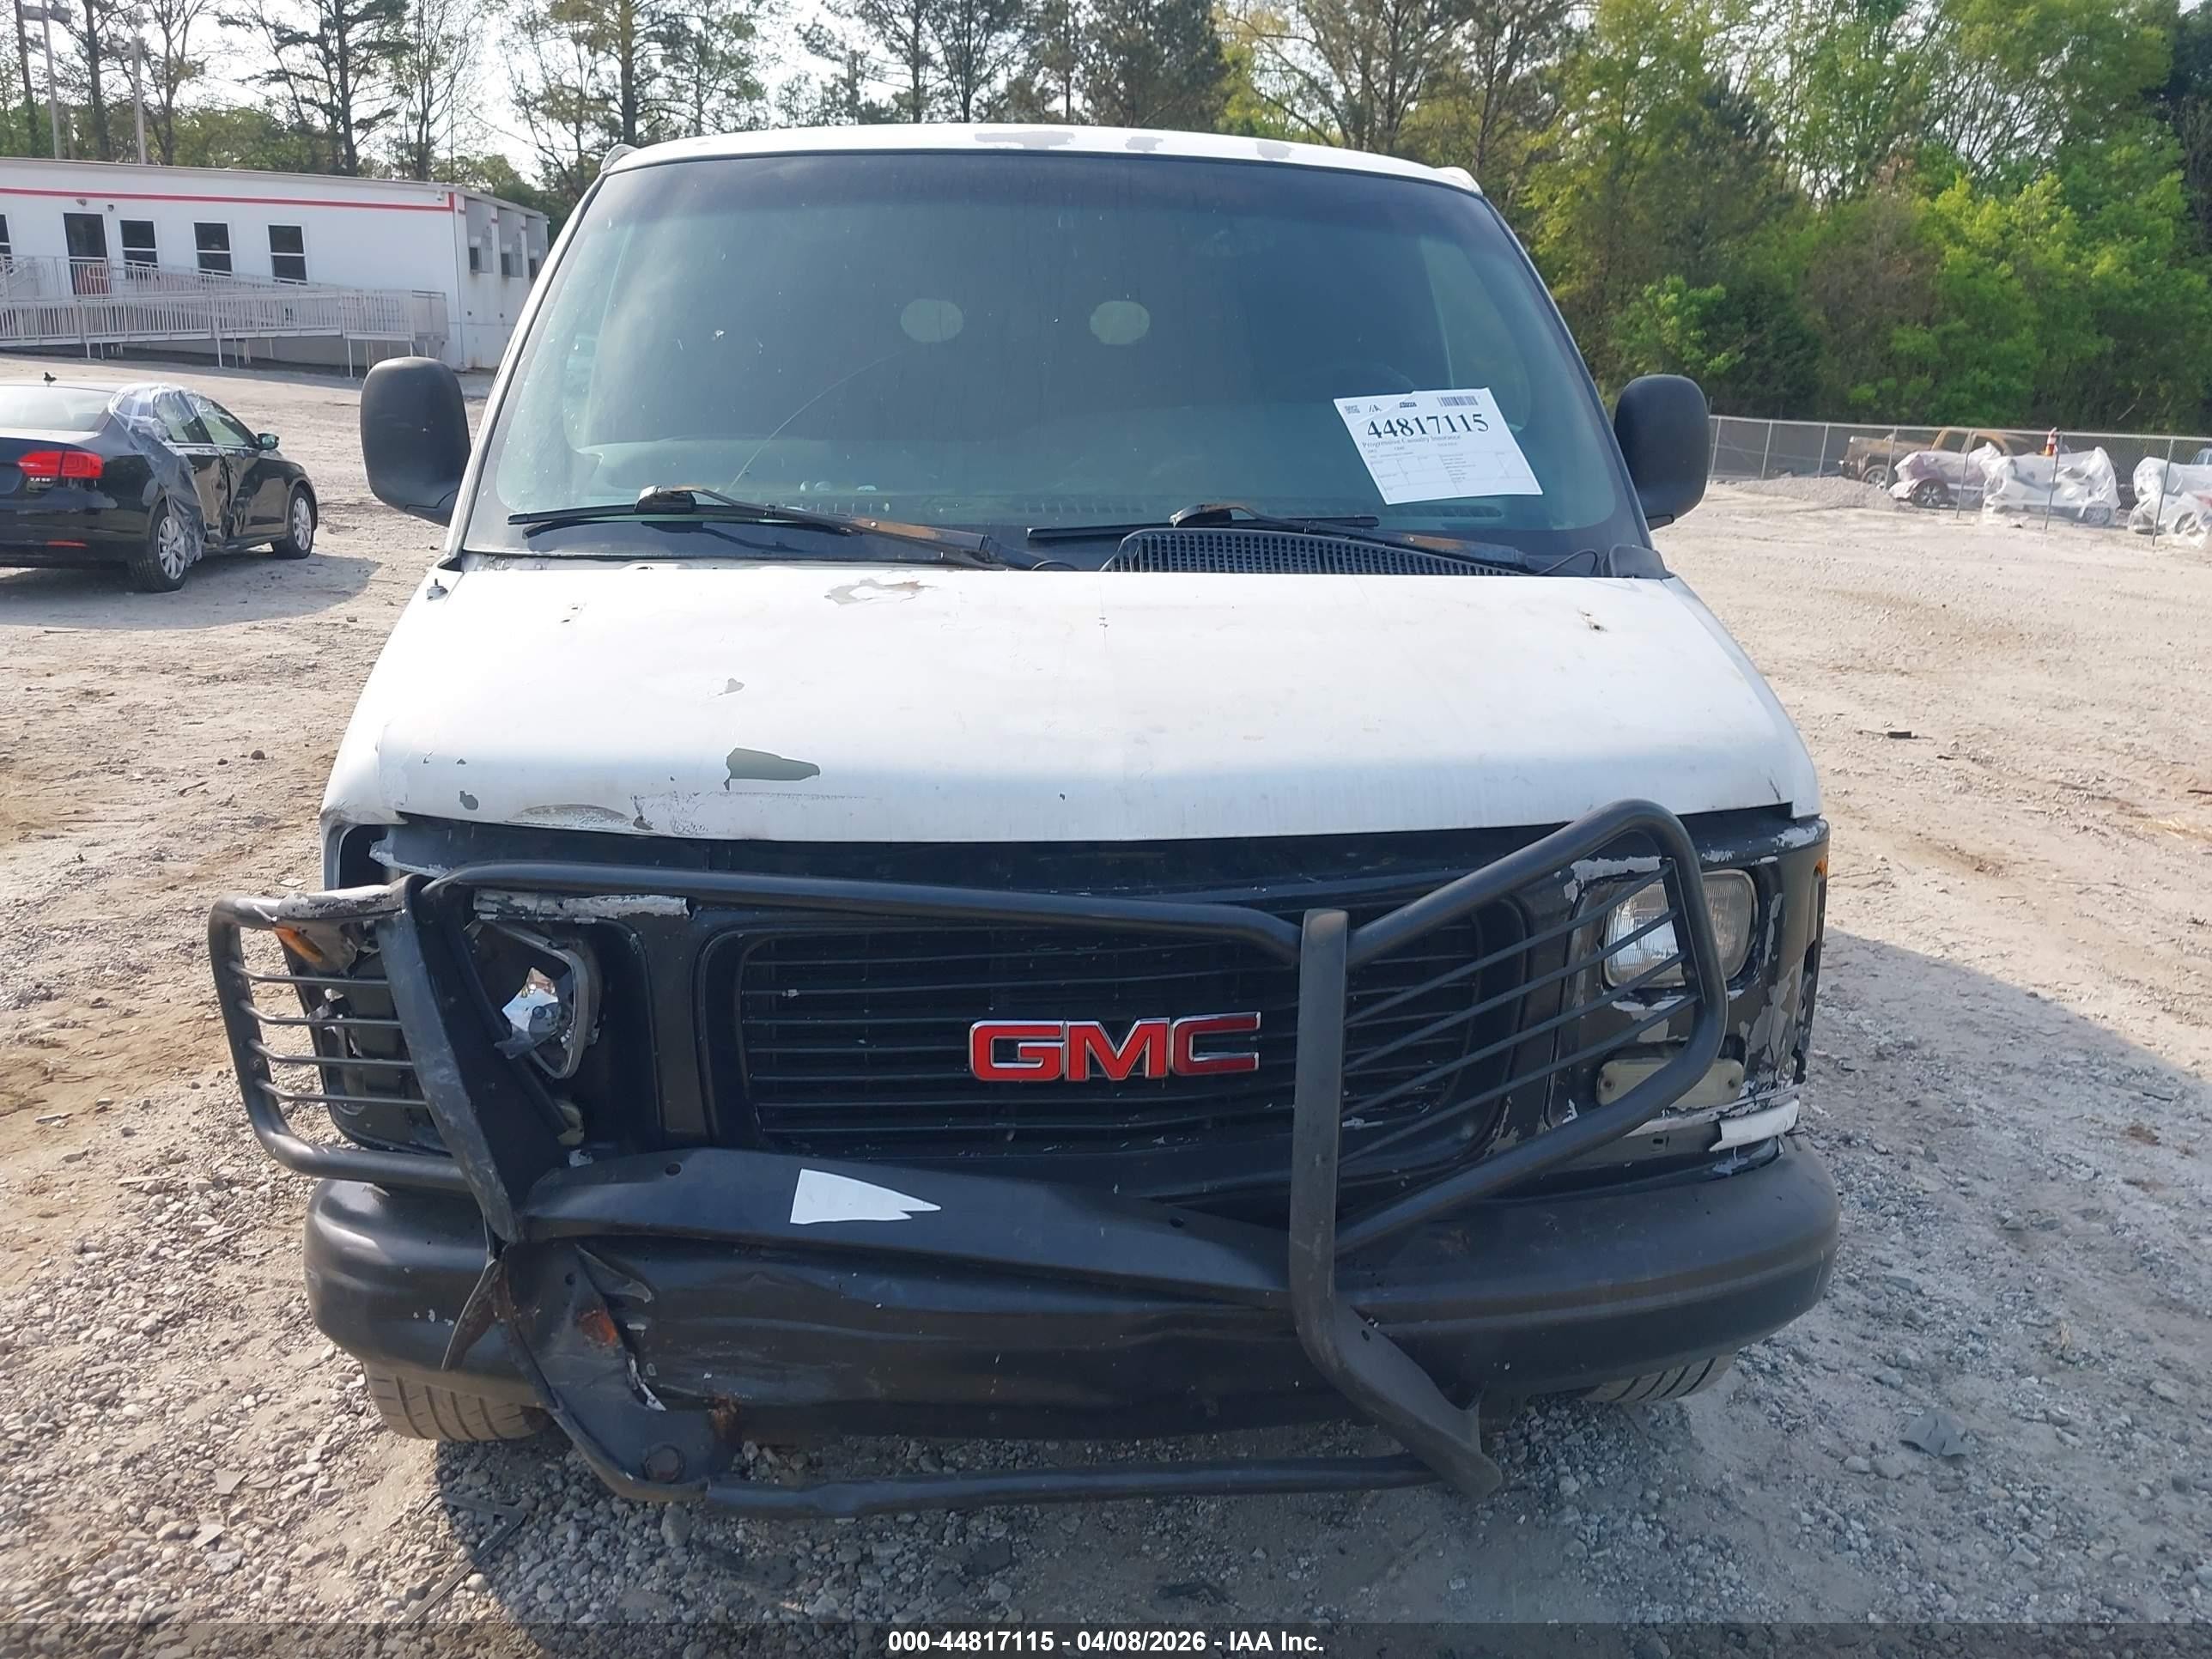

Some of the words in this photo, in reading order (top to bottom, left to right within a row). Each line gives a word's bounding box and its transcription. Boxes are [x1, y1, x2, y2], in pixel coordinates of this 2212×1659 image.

[1367, 414, 1489, 439] 44817115
[1362, 438, 1401, 448] Progressive
[969, 1012, 1261, 1081] GMC
